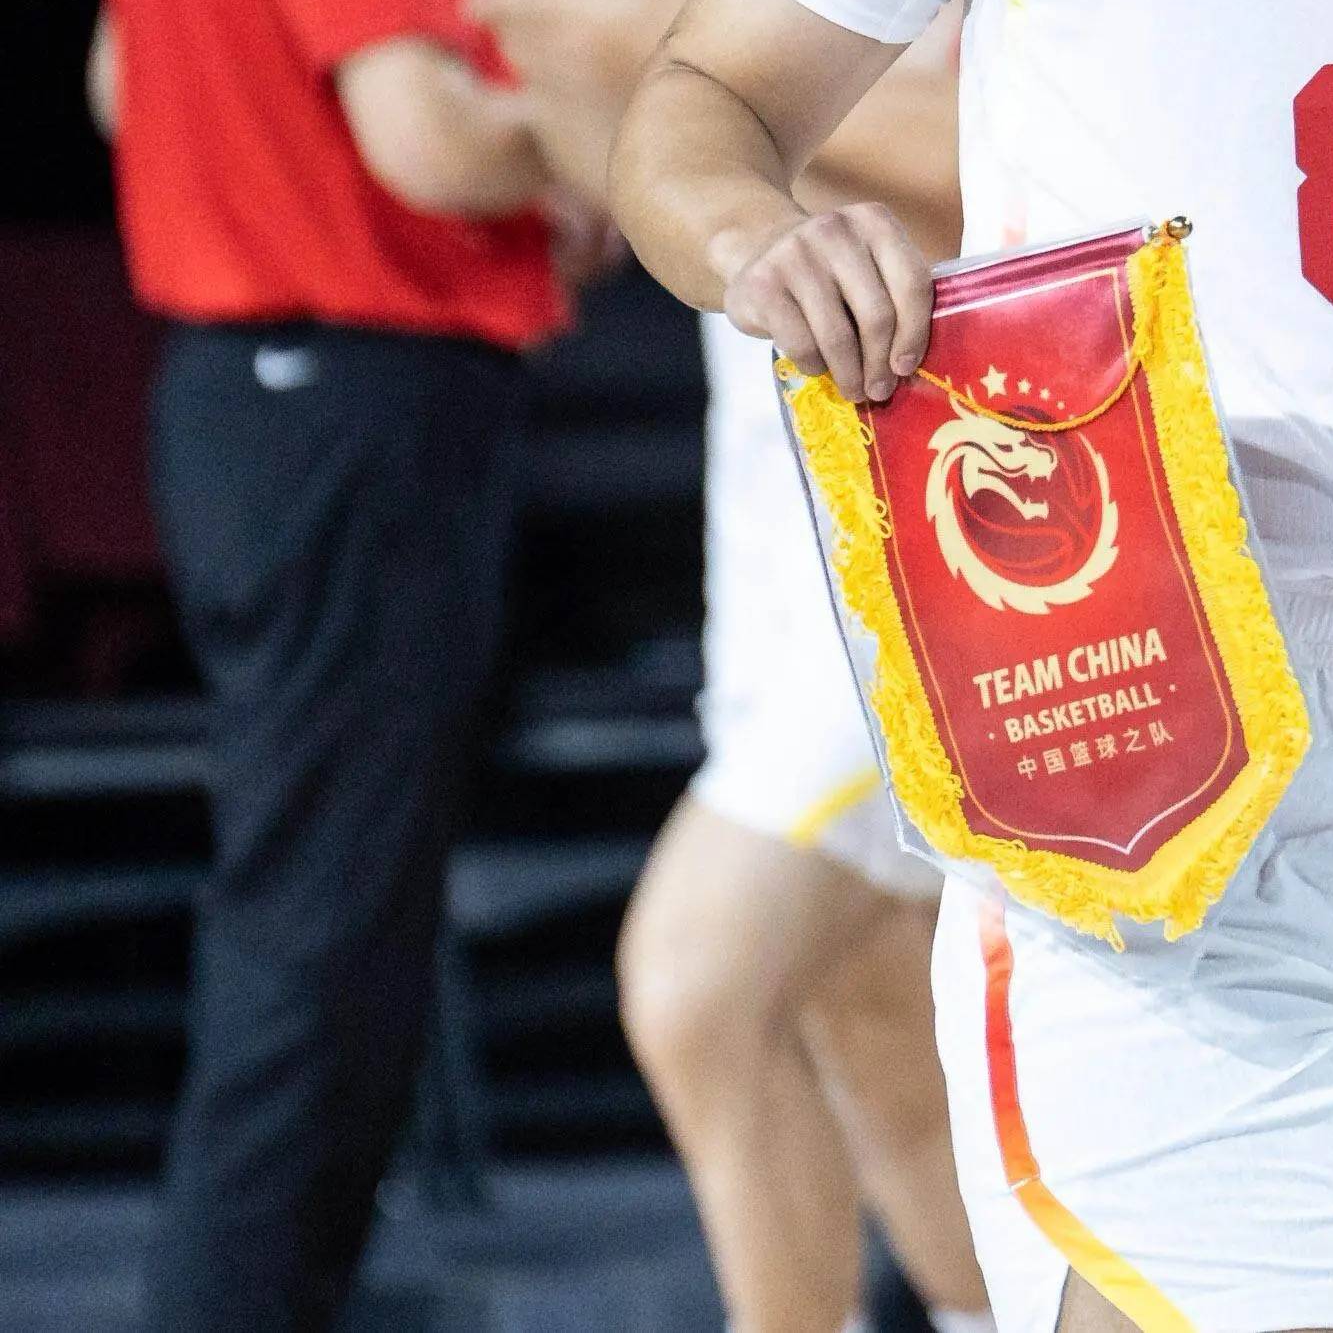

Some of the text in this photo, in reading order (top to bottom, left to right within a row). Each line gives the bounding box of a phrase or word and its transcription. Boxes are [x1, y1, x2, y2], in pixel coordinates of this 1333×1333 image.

[972, 627, 1168, 710] TEAM CHINA
[1004, 680, 1162, 743] BASKETBALL
[1016, 722, 1175, 782] 中国篮球之队
